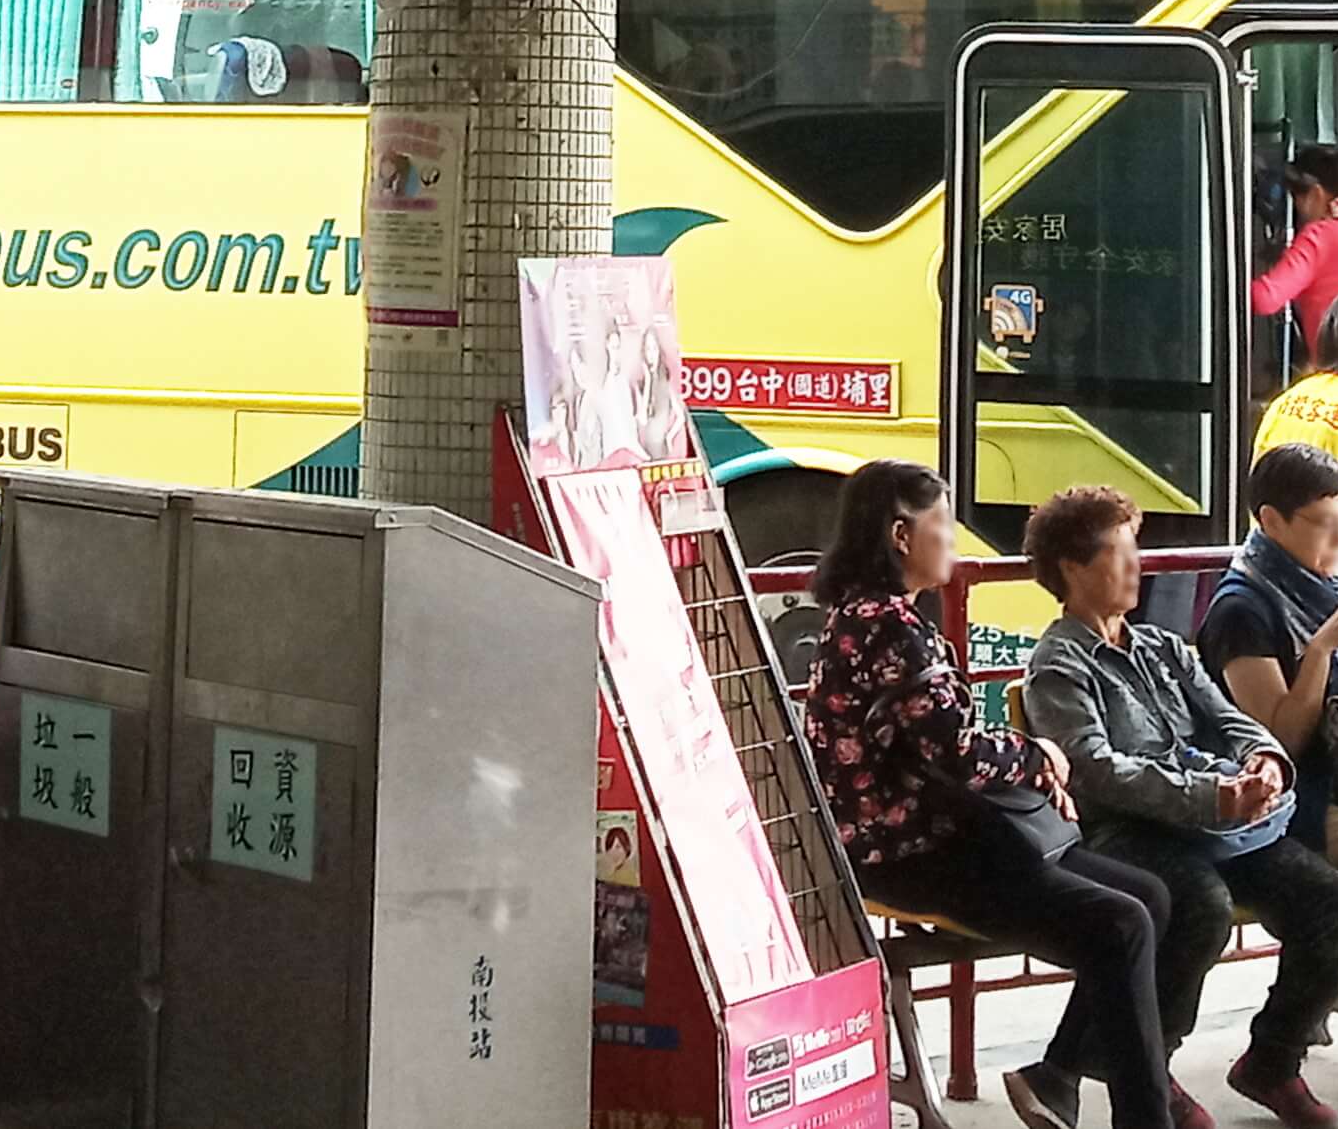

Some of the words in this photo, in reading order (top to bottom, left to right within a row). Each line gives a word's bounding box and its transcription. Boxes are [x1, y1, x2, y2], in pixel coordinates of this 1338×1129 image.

[1010, 291, 1031, 304] 4G
[679, 366, 890, 407] 899台中(國道)埔里
[70, 731, 97, 820] 一般
[228, 749, 255, 851] 回收
[270, 749, 299, 863] 資源
[469, 956, 494, 1061] 南投站
